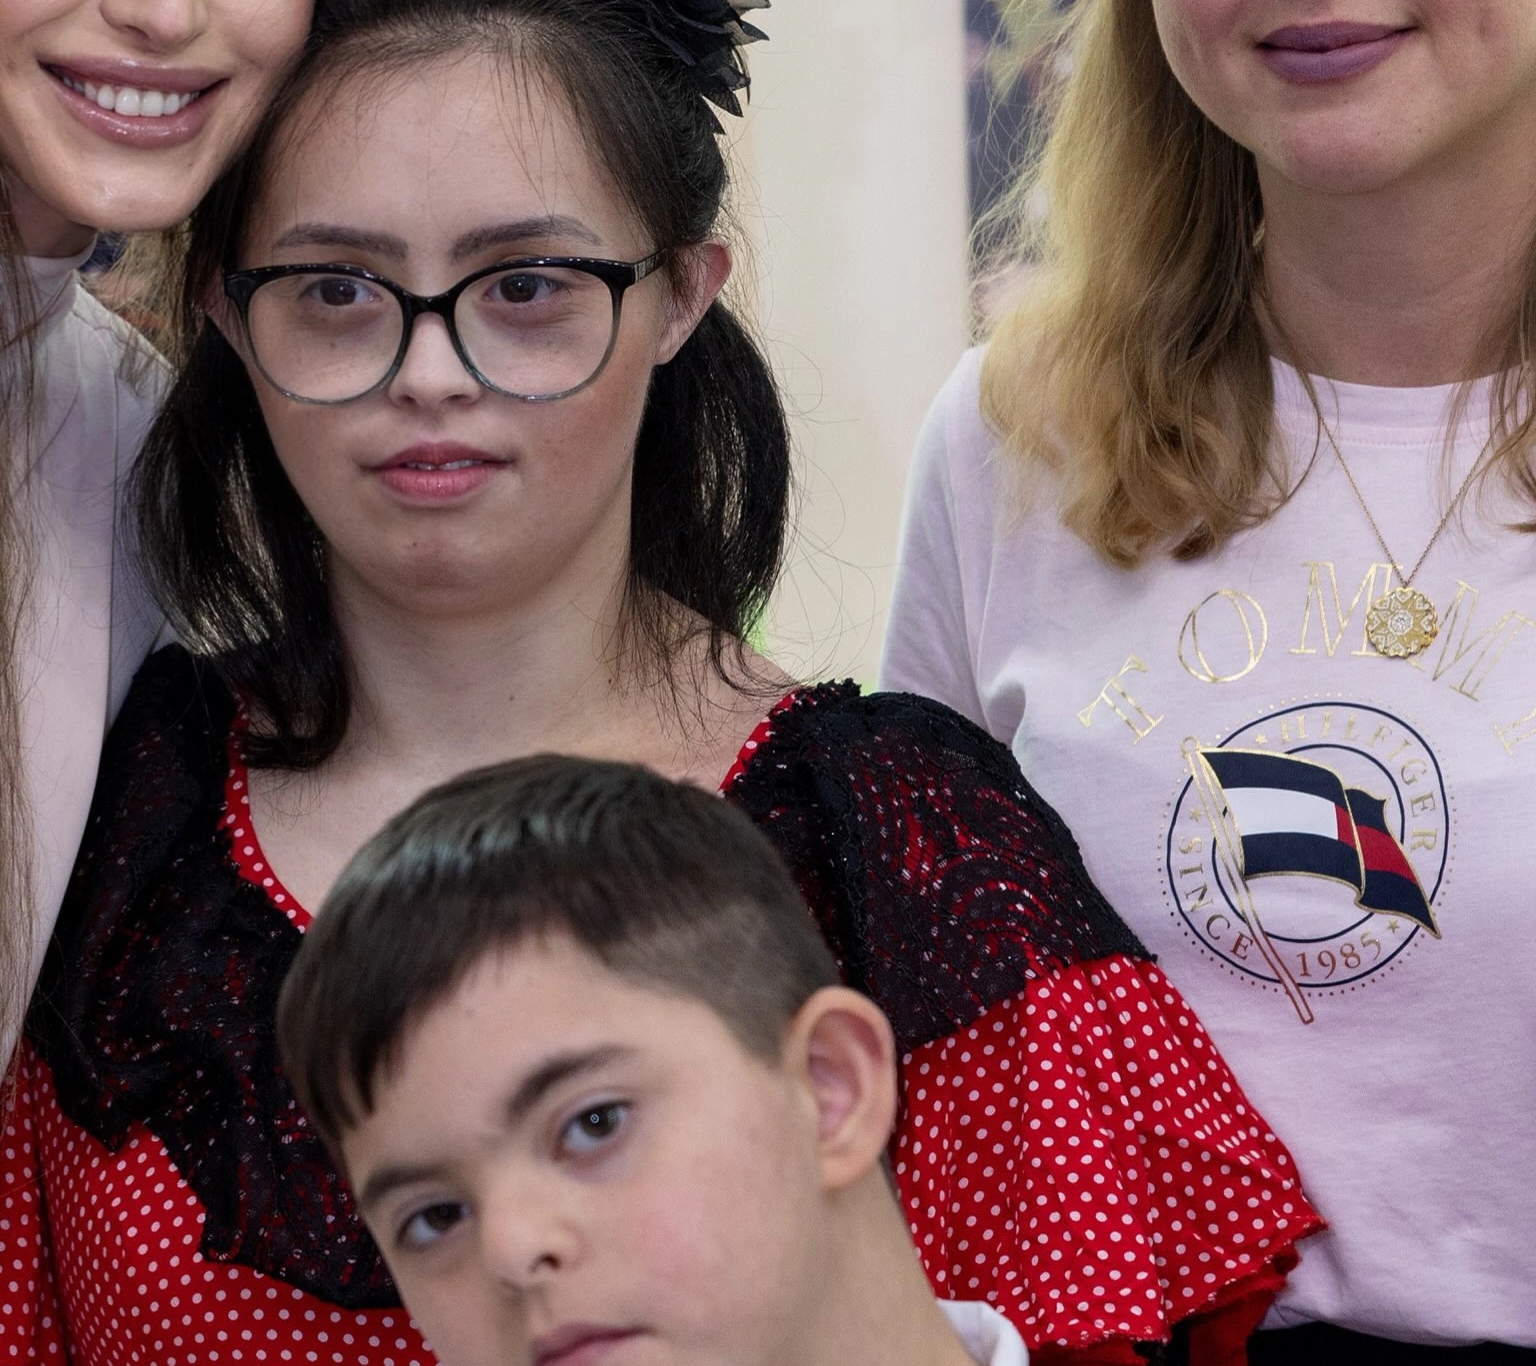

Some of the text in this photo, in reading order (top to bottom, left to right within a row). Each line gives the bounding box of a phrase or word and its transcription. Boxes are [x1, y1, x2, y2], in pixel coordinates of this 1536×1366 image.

[1279, 712, 1437, 852] HILFIGER
[1178, 836, 1382, 979] SINCE 1985
